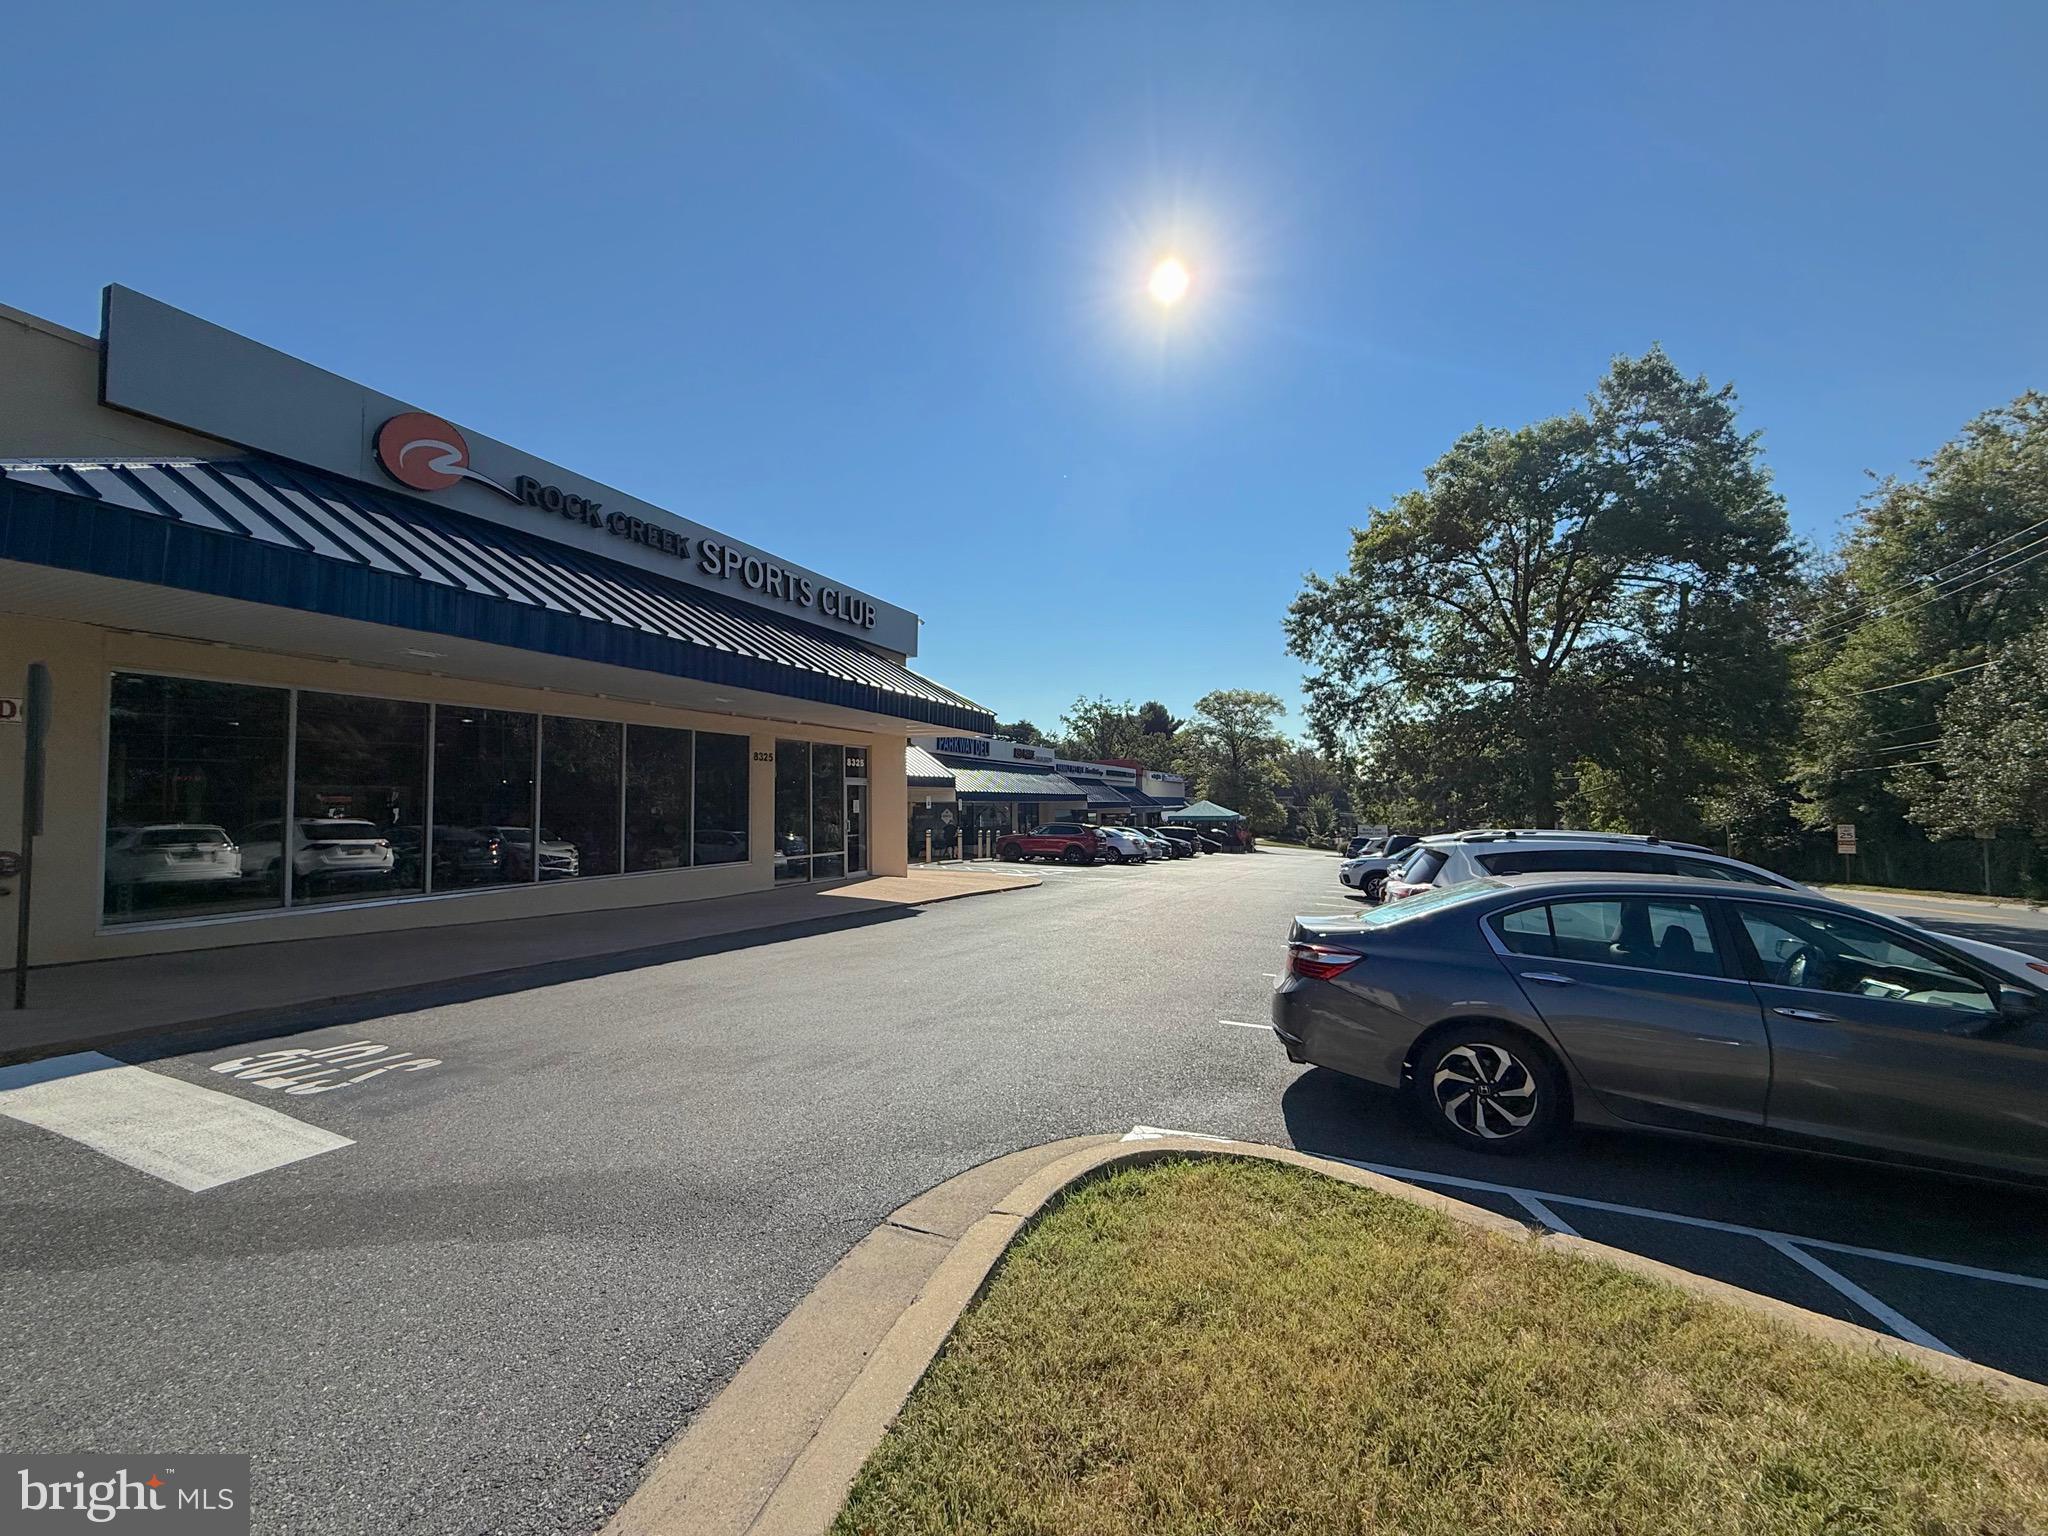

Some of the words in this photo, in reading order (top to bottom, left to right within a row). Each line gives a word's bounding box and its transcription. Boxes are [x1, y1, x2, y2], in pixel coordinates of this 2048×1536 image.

[517, 474, 604, 528] ROCK
[606, 511, 691, 560] CREEK
[697, 537, 815, 608] SPORTS
[820, 587, 878, 630] CLUB
[936, 737, 973, 754] PARKWAY
[753, 751, 774, 762] 8325
[846, 758, 865, 767] 8325
[209, 1040, 443, 1095] STOP
